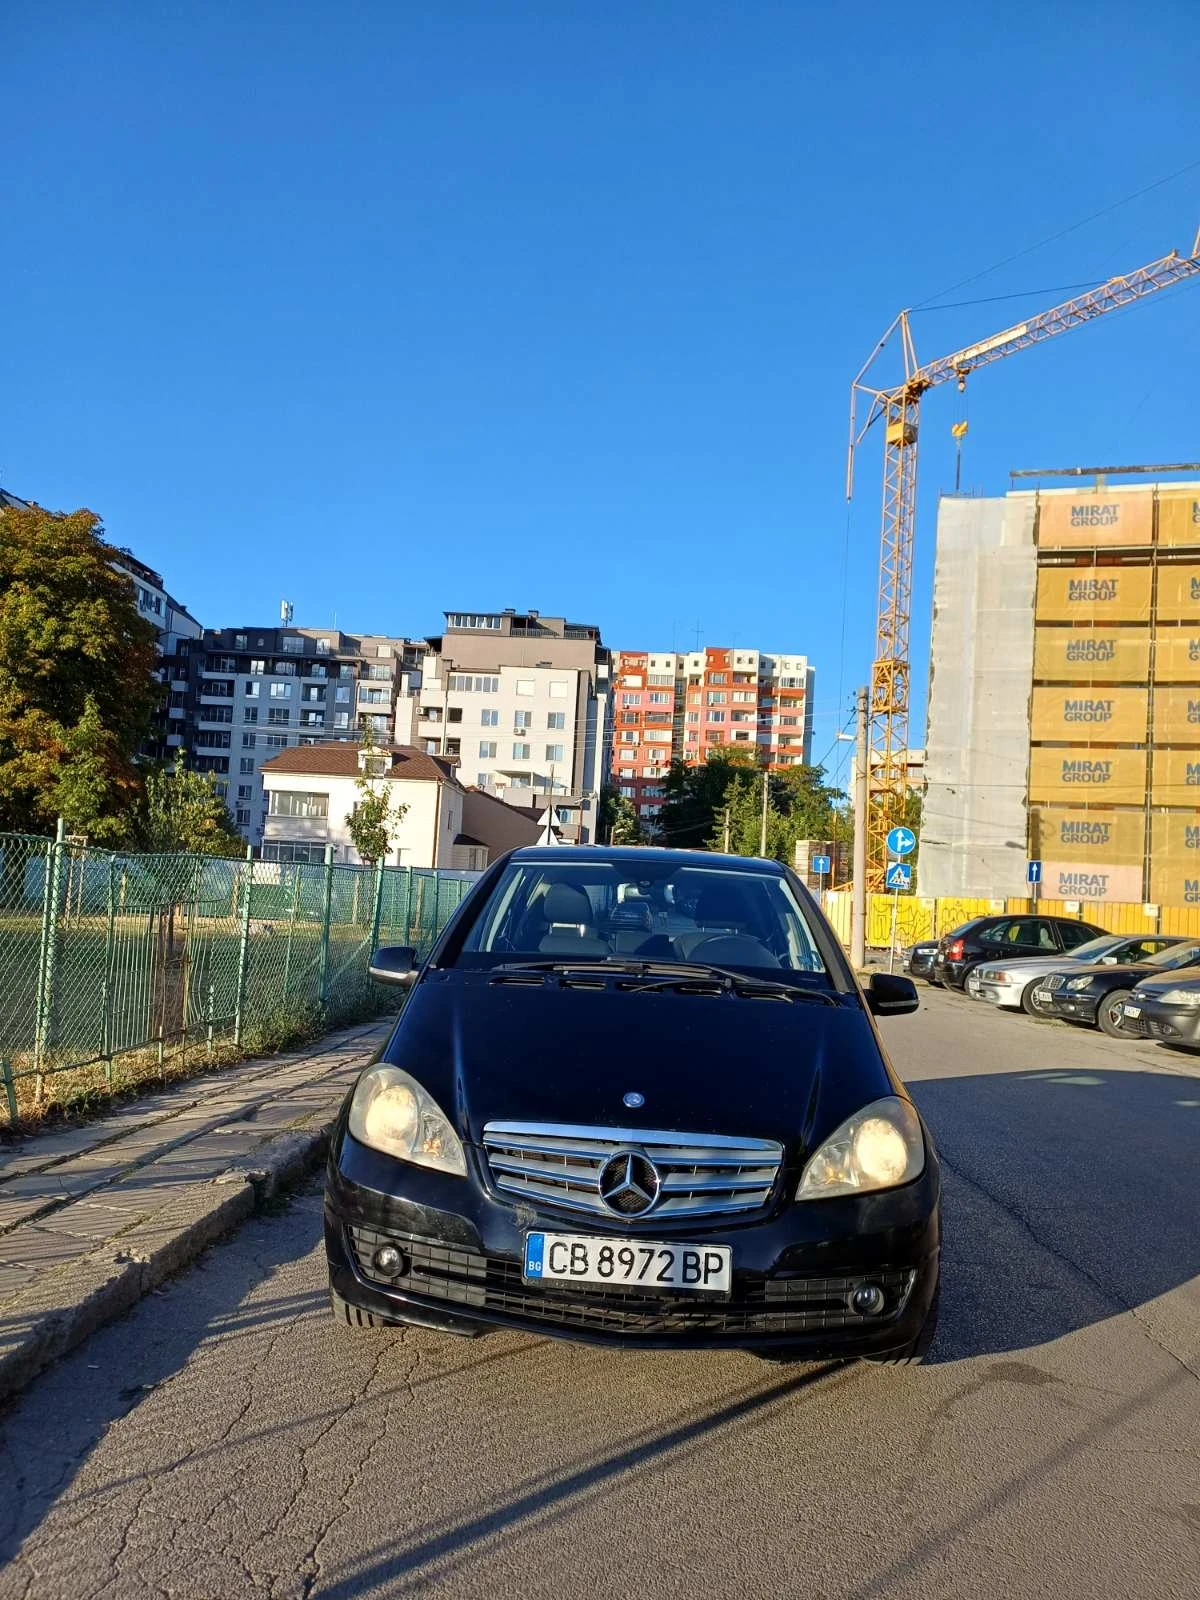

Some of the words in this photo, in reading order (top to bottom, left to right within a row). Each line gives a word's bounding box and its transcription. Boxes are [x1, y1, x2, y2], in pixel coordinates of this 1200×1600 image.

[1071, 504, 1120, 517] MIRAT
[1070, 516, 1118, 527] GROUP
[1068, 579, 1119, 592] MIRAT
[1068, 590, 1117, 601] GROUP
[1066, 639, 1117, 652] MIRAT
[1066, 651, 1115, 662] GROUP
[1064, 699, 1114, 713] MIRAT
[1064, 712, 1112, 723] GROUP
[1062, 759, 1112, 773] MIRAT
[1062, 772, 1111, 784] GROUP
[1060, 820, 1111, 835] MIRAT
[1060, 833, 1110, 845] GROUP
[1058, 872, 1109, 887] MIRAT
[1058, 885, 1107, 897] GROUP
[528, 1260, 542, 1272] BG
[548, 1241, 589, 1276] CB
[597, 1245, 676, 1282] 8972
[682, 1251, 724, 1285] BP
